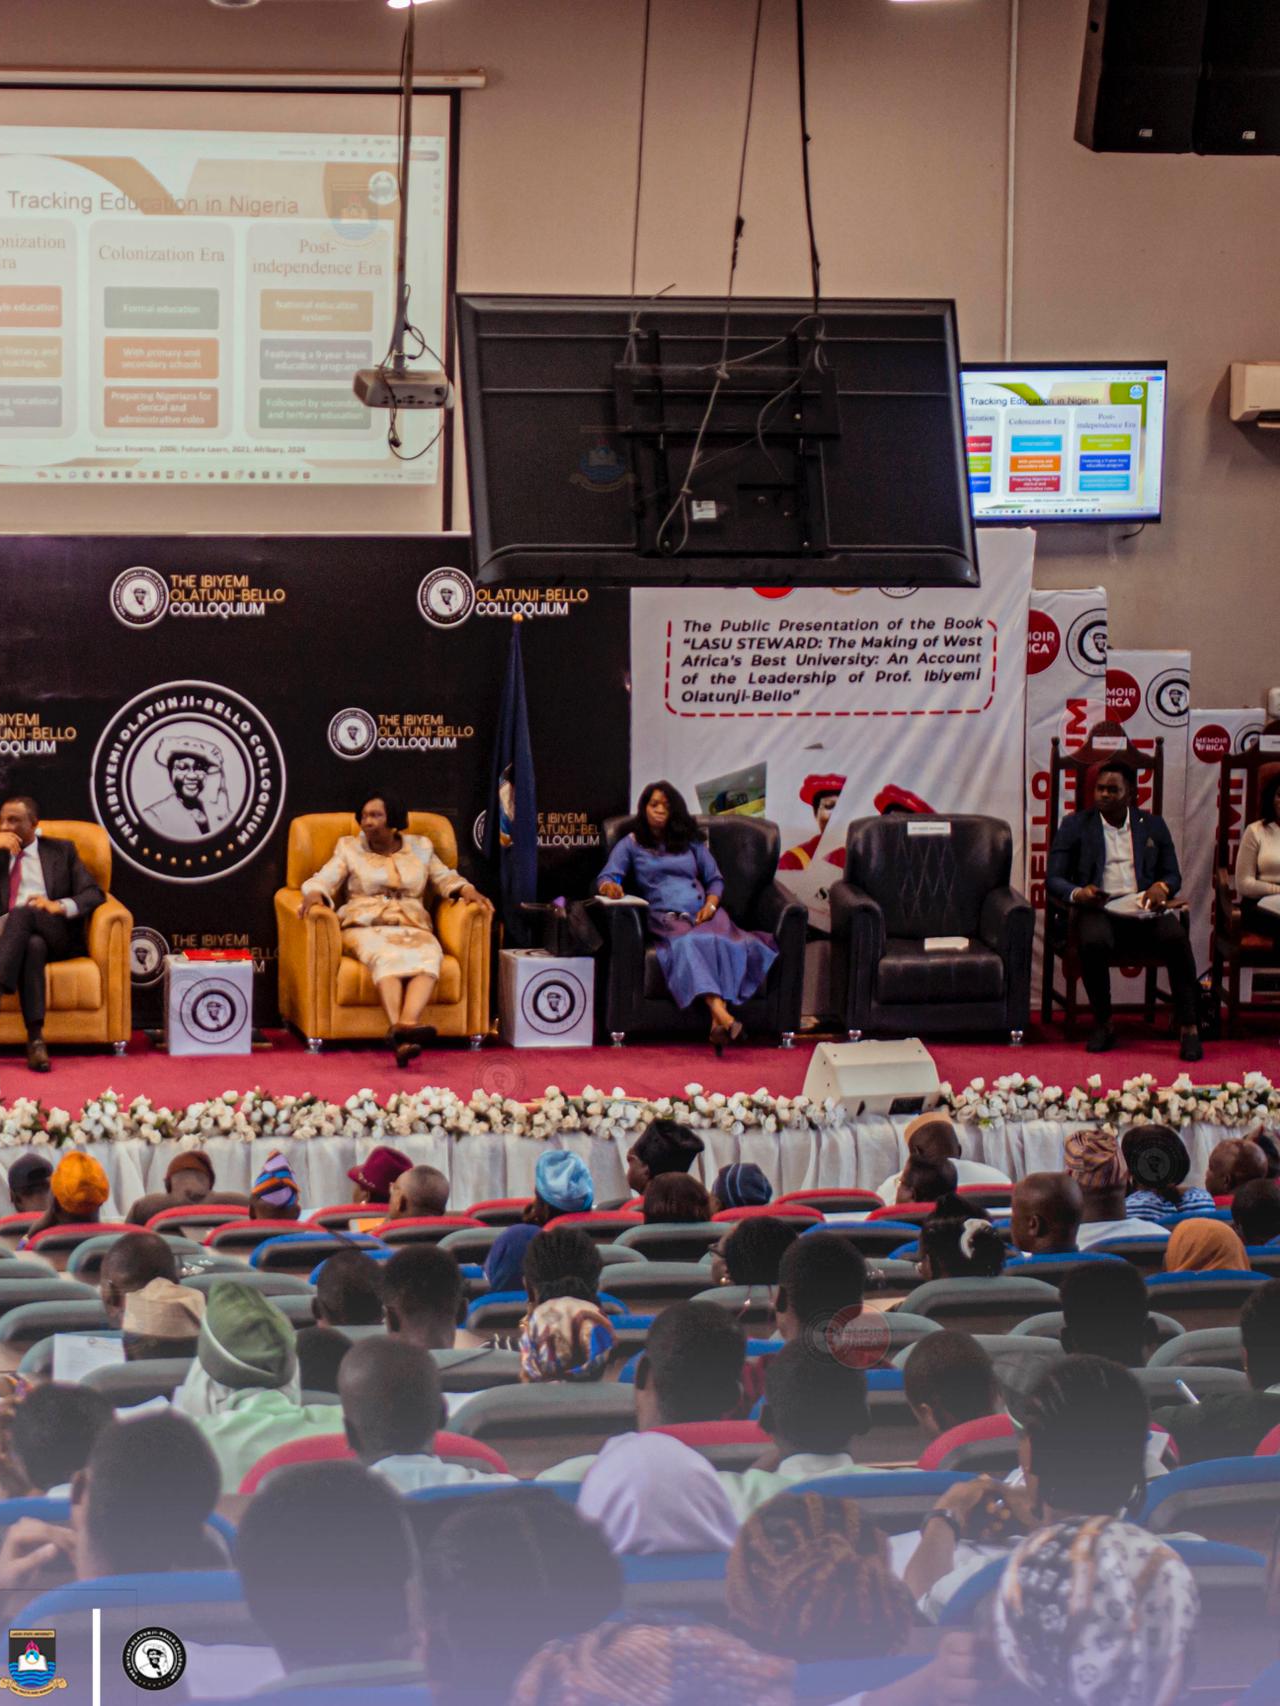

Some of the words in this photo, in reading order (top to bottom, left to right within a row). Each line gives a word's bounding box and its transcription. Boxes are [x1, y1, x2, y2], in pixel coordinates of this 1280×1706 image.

[8, 190, 92, 214] Tracking
[100, 191, 198, 211] Education
[206, 197, 226, 212] in
[230, 197, 299, 216] Nigeria
[98, 246, 194, 262] Colonization
[200, 248, 225, 262] Era
[298, 239, 336, 254] Post-
[252, 260, 352, 277] independence
[358, 261, 383, 276] Era
[970, 398, 1007, 406] Tracking
[170, 574, 196, 588] THE
[201, 574, 248, 588] IBIYEMI
[170, 588, 286, 601] OLATUNJI-BELLO
[476, 588, 588, 602] OLATUNJI-BELLO
[170, 602, 265, 618] COLLOQUIUM
[476, 602, 568, 618] COLLOQUIUM
[684, 620, 712, 632] The
[720, 619, 770, 632] Public
[778, 618, 878, 632] Presentation
[887, 618, 904, 630] of
[910, 618, 936, 630] the
[944, 617, 984, 630] Book
[736, 637, 822, 650] STEWARD:
[828, 636, 856, 649] The
[861, 636, 918, 650] Making
[923, 636, 940, 648] of
[944, 635, 982, 647] West
[682, 654, 742, 667] Africa's
[751, 654, 786, 666] Best
[796, 653, 880, 668] University:
[887, 653, 908, 665] An
[917, 652, 982, 664] Account
[682, 672, 698, 685] of
[710, 672, 736, 684] the
[748, 671, 836, 686] Leadership
[848, 671, 865, 683] of
[875, 670, 912, 683] Prof.
[924, 668, 982, 684] Ibiyemi
[120, 696, 252, 742] OLATUNJI-BELLO
[378, 714, 400, 726] THE
[404, 714, 444, 726] IBIYEMI
[378, 726, 474, 737] OLATUNJI-BELLO
[378, 737, 457, 751] COLLOQUIUM
[1196, 737, 1228, 745] MEMOIR
[106, 743, 124, 812] IBIYEMI
[238, 734, 272, 845] COLLOQUIUM
[548, 812, 588, 824] IBIYEMI
[115, 814, 139, 848] THE
[172, 934, 198, 946] THE
[202, 934, 249, 946] IBIYEMI
